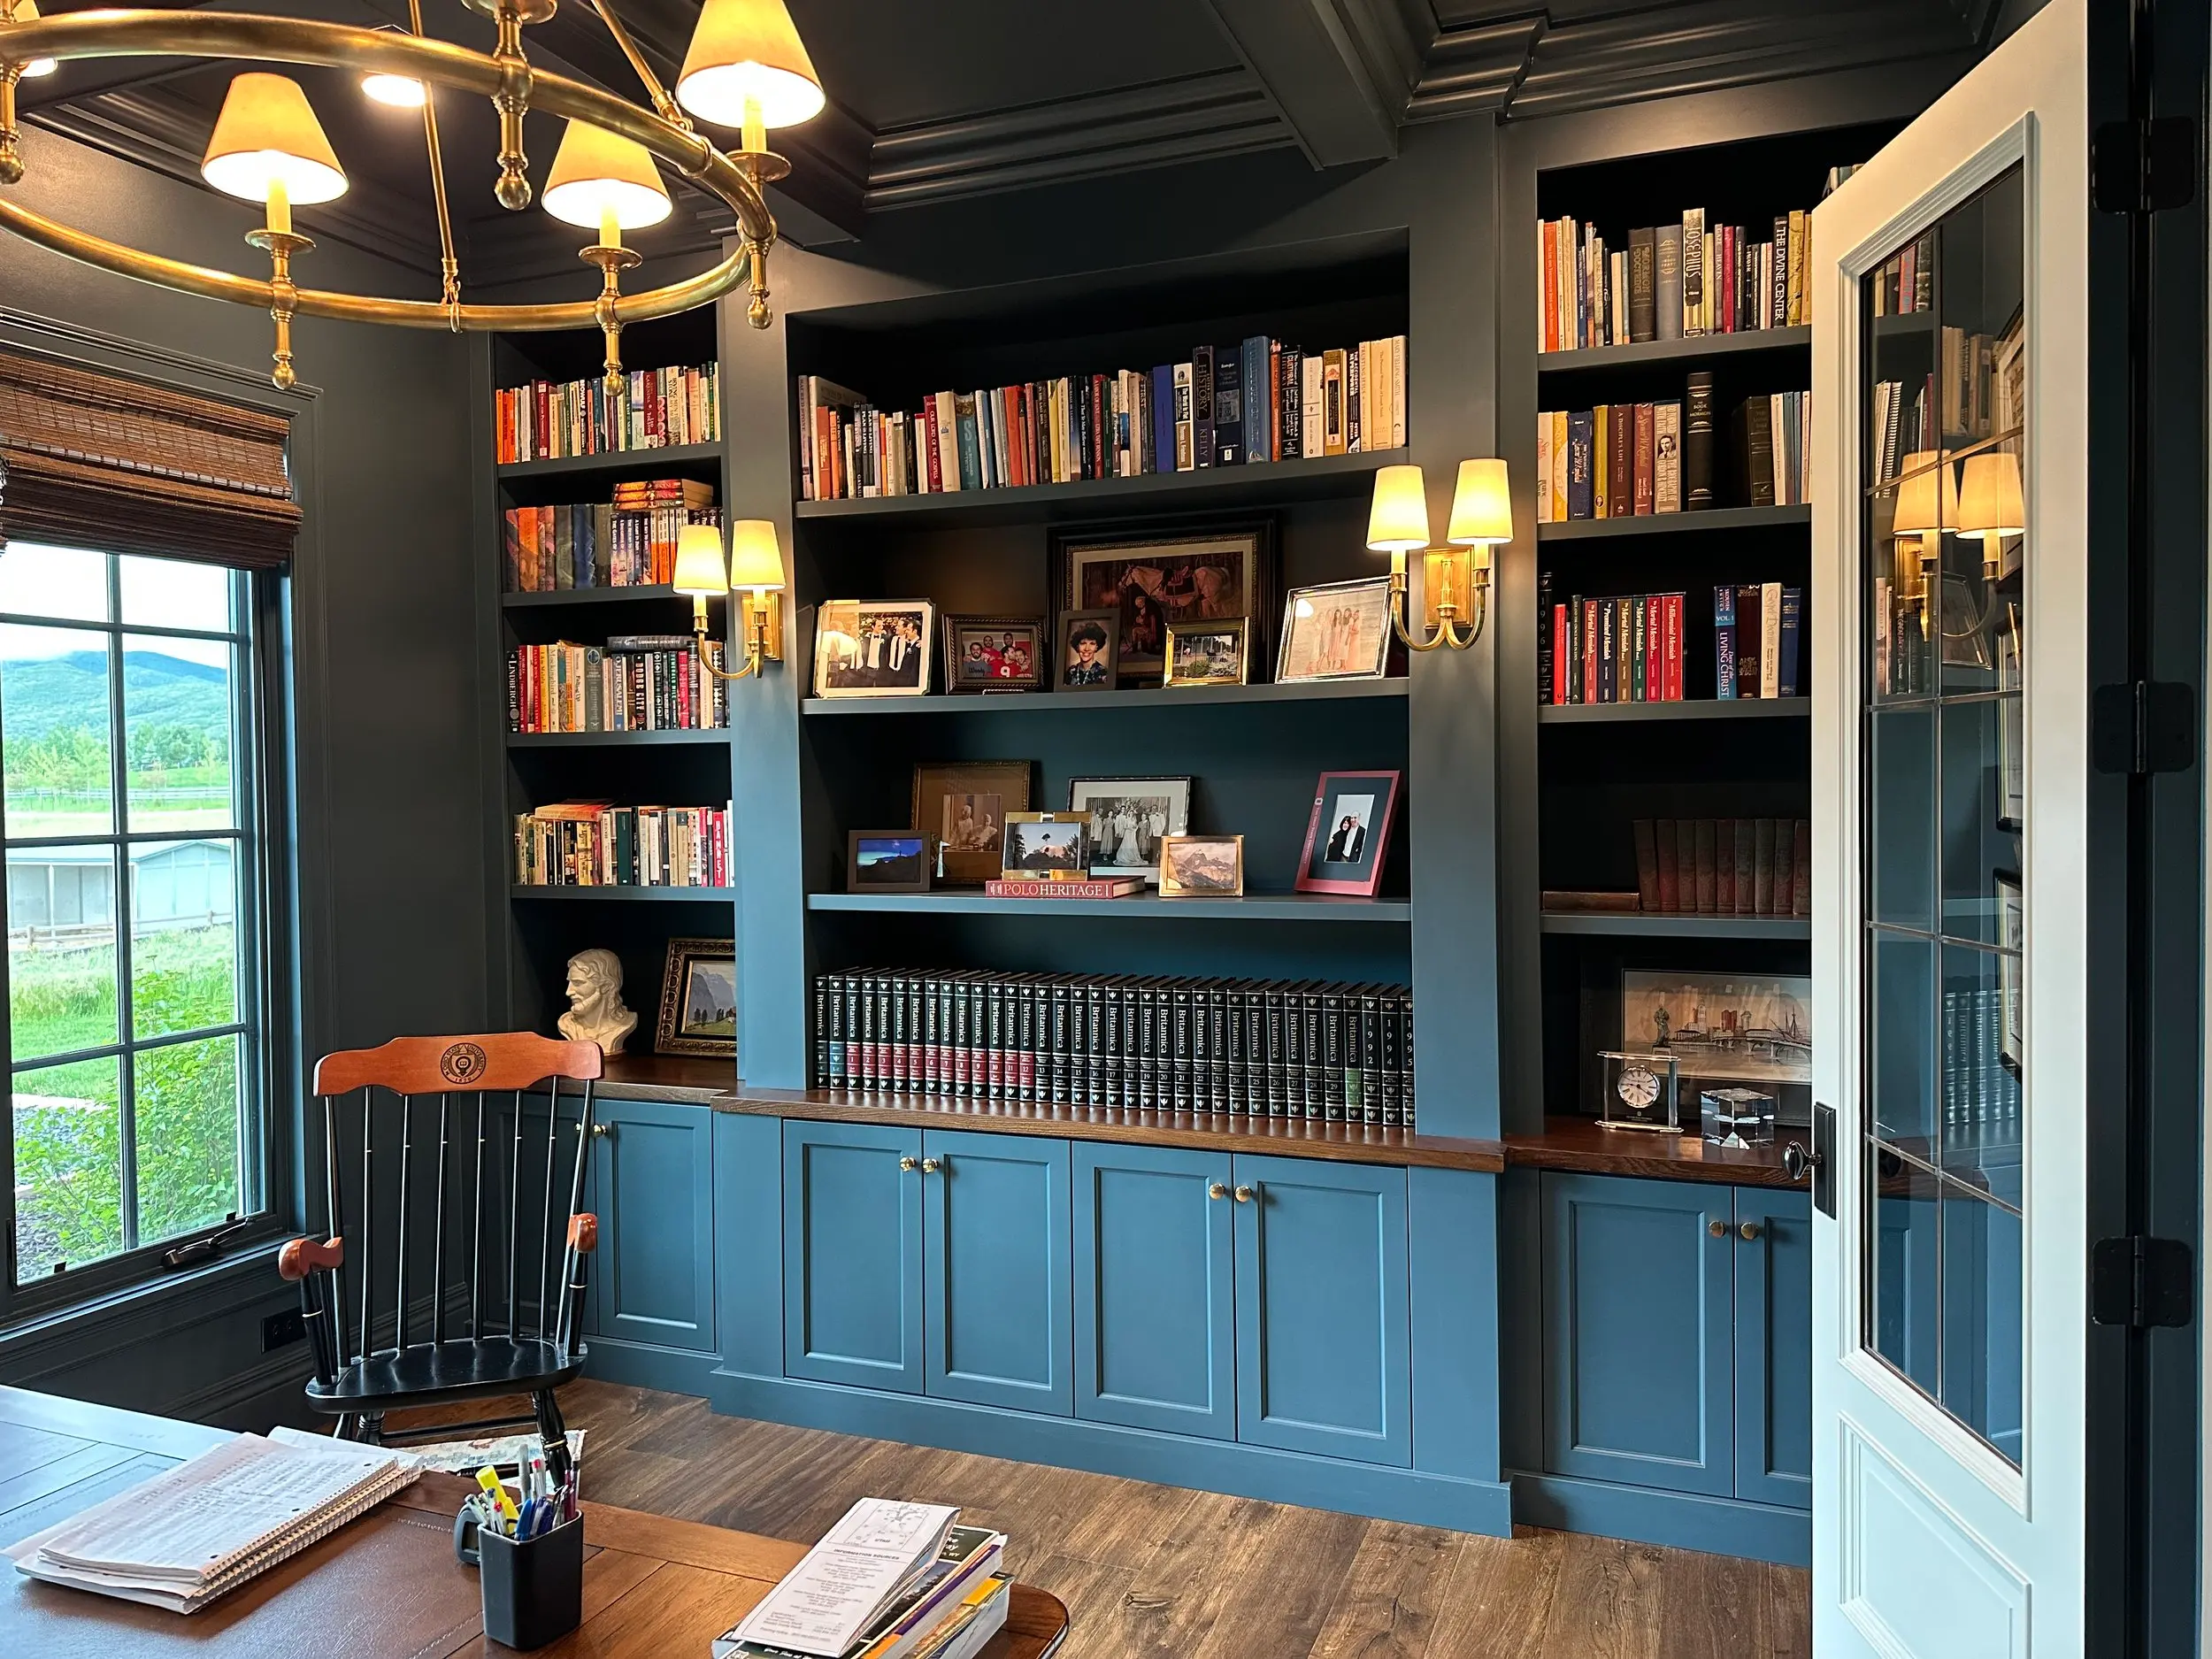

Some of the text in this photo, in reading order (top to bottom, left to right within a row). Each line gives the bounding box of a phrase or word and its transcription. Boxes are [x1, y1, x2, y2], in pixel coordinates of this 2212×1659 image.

[1641, 248, 1650, 293] MORMON
[1686, 227, 1701, 277] JOSEPHUS
[1774, 227, 1786, 320] THE DIVINE CENTER
[1199, 364, 1208, 412] HISTORY
[1199, 428, 1208, 457] KELLY
[1667, 470, 1678, 495] BIOGRAPHY
[508, 660, 517, 708] LINDBERGH
[635, 663, 645, 710] DODGE CITY
[1000, 665, 1010, 677] 9
[1719, 632, 1729, 697] LIVING CHRIST
[1040, 884, 1102, 896] HERITAGE
[1007, 1001, 1016, 1046] Britannica
[1074, 1004, 1083, 1049] Britannica
[1109, 1006, 1118, 1051] Britannica
[1126, 1007, 1135, 1053] Britannica
[1143, 1008, 1152, 1053] Britannica
[1160, 1008, 1169, 1054] Britannica
[1178, 1009, 1187, 1055] Britannica
[1196, 1009, 1205, 1055] Britannica
[1232, 1010, 1240, 1057] Britannica
[1271, 1011, 1279, 1058] Britannica
[1289, 1013, 1299, 1059] Britannica
[1309, 1014, 1318, 1061] Britannica
[1329, 1015, 1338, 1062] Britannica
[1348, 1016, 1357, 1063] Britannica
[833, 1548, 872, 1557] INFORMATION
